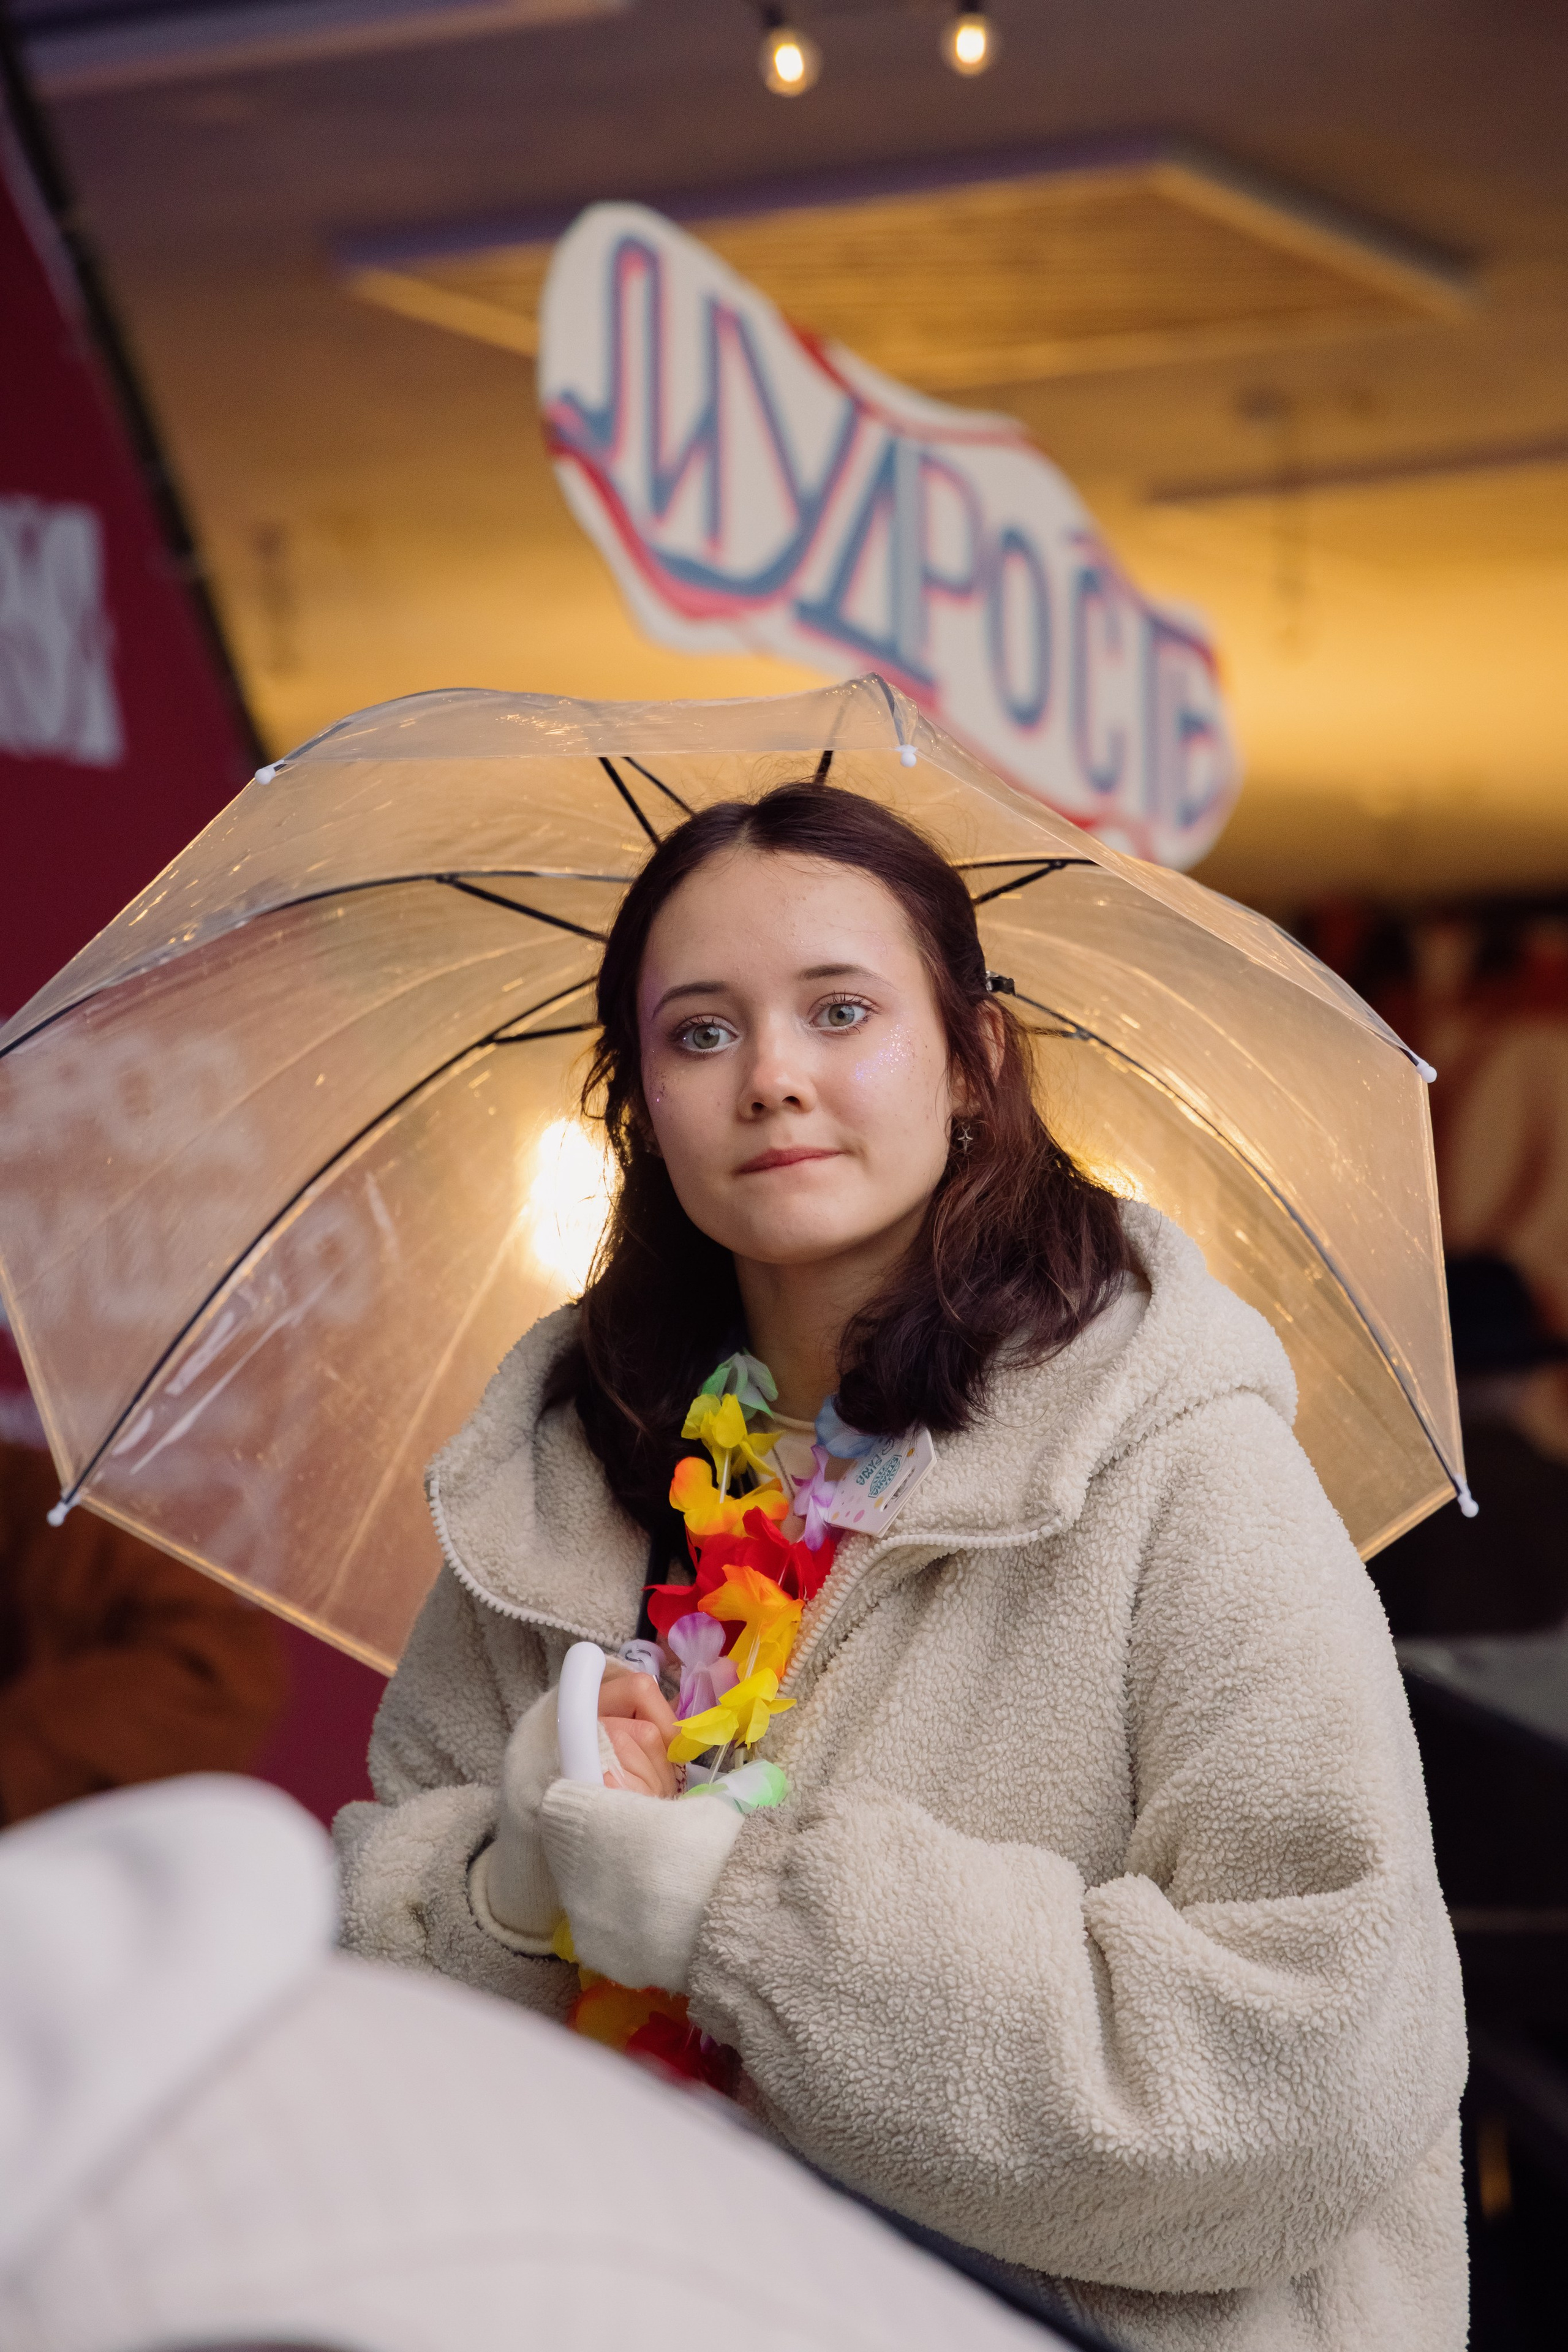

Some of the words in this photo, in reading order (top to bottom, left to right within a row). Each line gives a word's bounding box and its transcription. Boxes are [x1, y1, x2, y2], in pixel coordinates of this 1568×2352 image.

[855, 1454, 880, 1484] LAND
[859, 1457, 883, 1486] SIMA
[873, 1457, 899, 1496] СТРАНА
